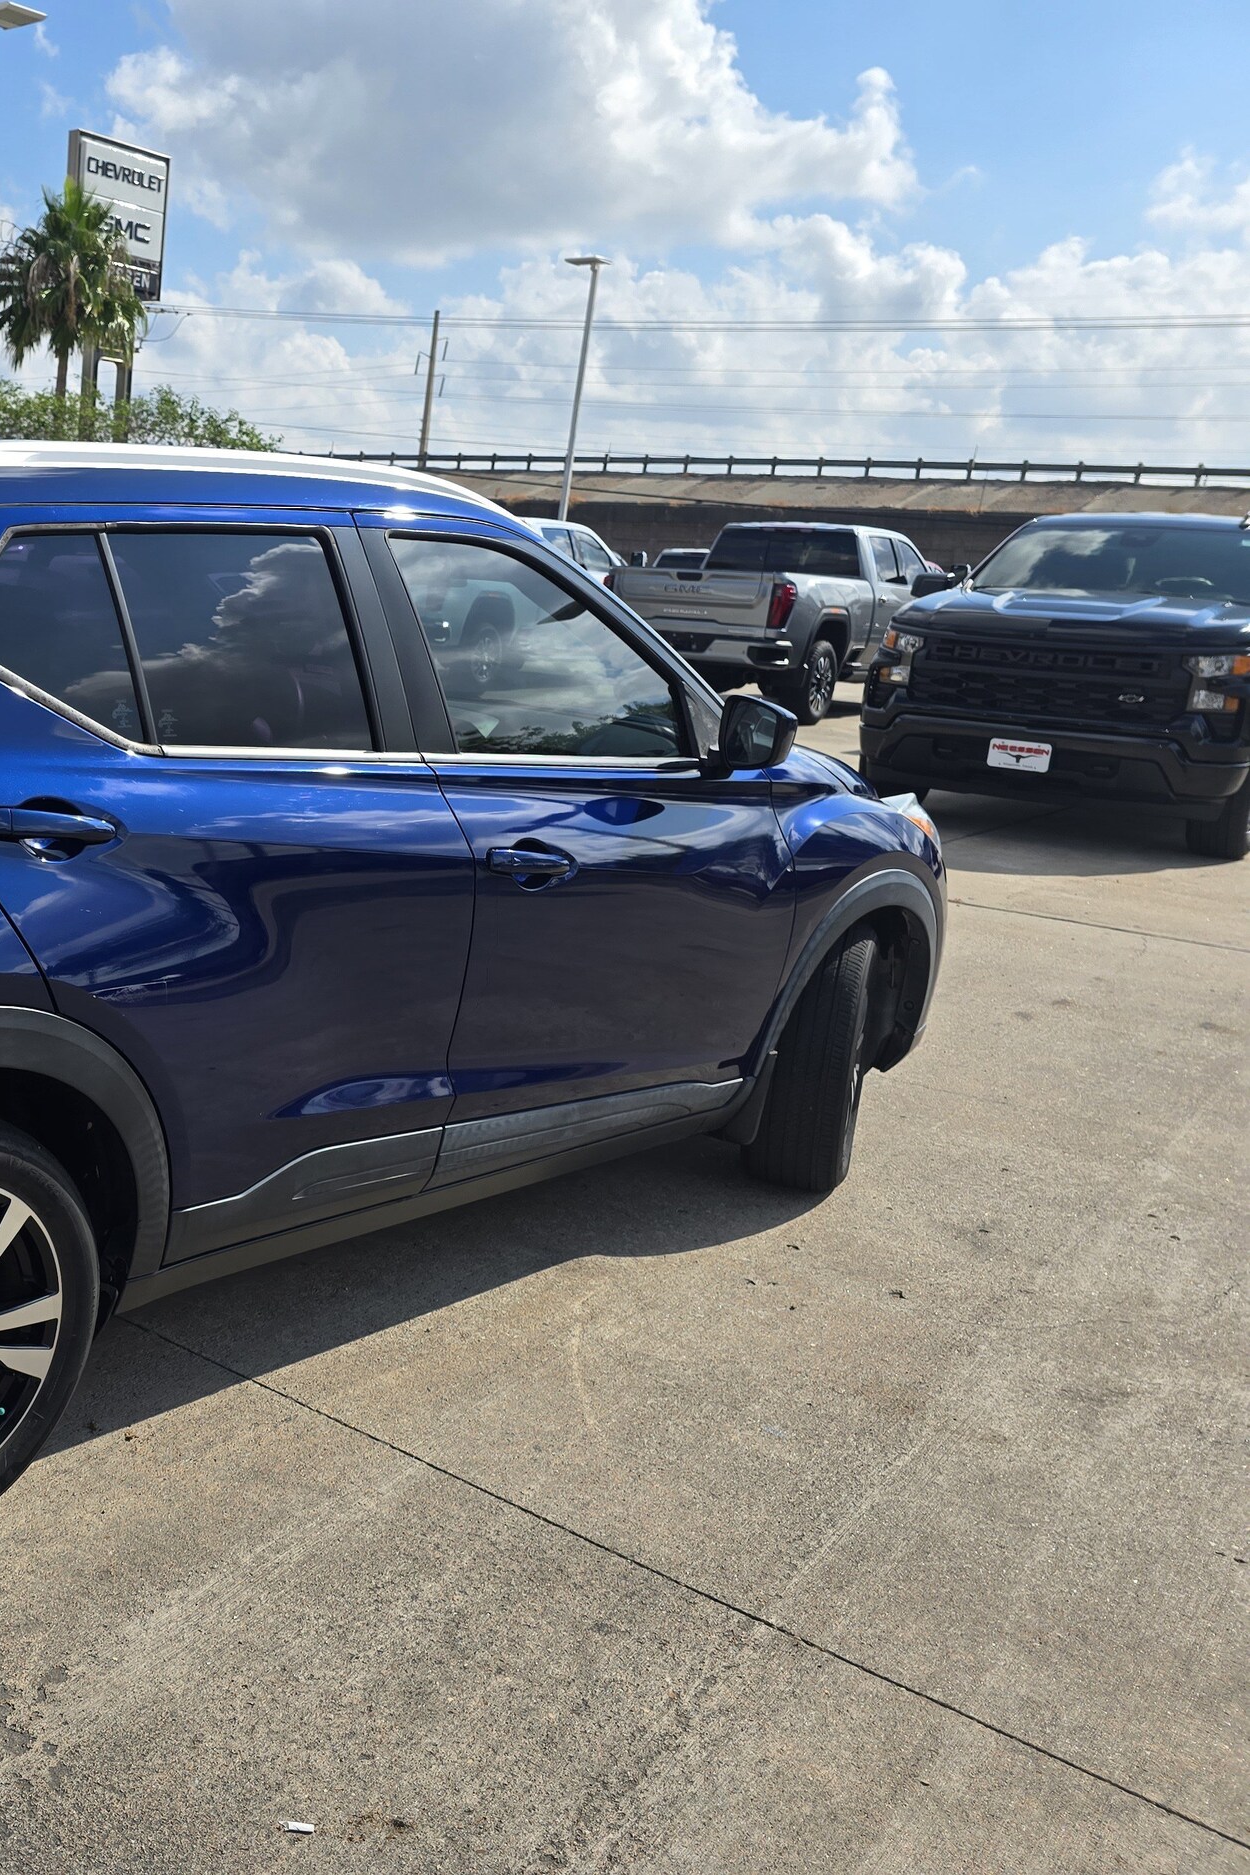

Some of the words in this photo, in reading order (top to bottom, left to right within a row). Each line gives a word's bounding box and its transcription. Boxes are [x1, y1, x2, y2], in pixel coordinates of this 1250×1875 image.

[87, 156, 164, 192] CHEVROLET
[664, 583, 710, 595] GMC
[931, 643, 1163, 672] CHEVROLET
[992, 743, 1049, 756] NEESSEN
